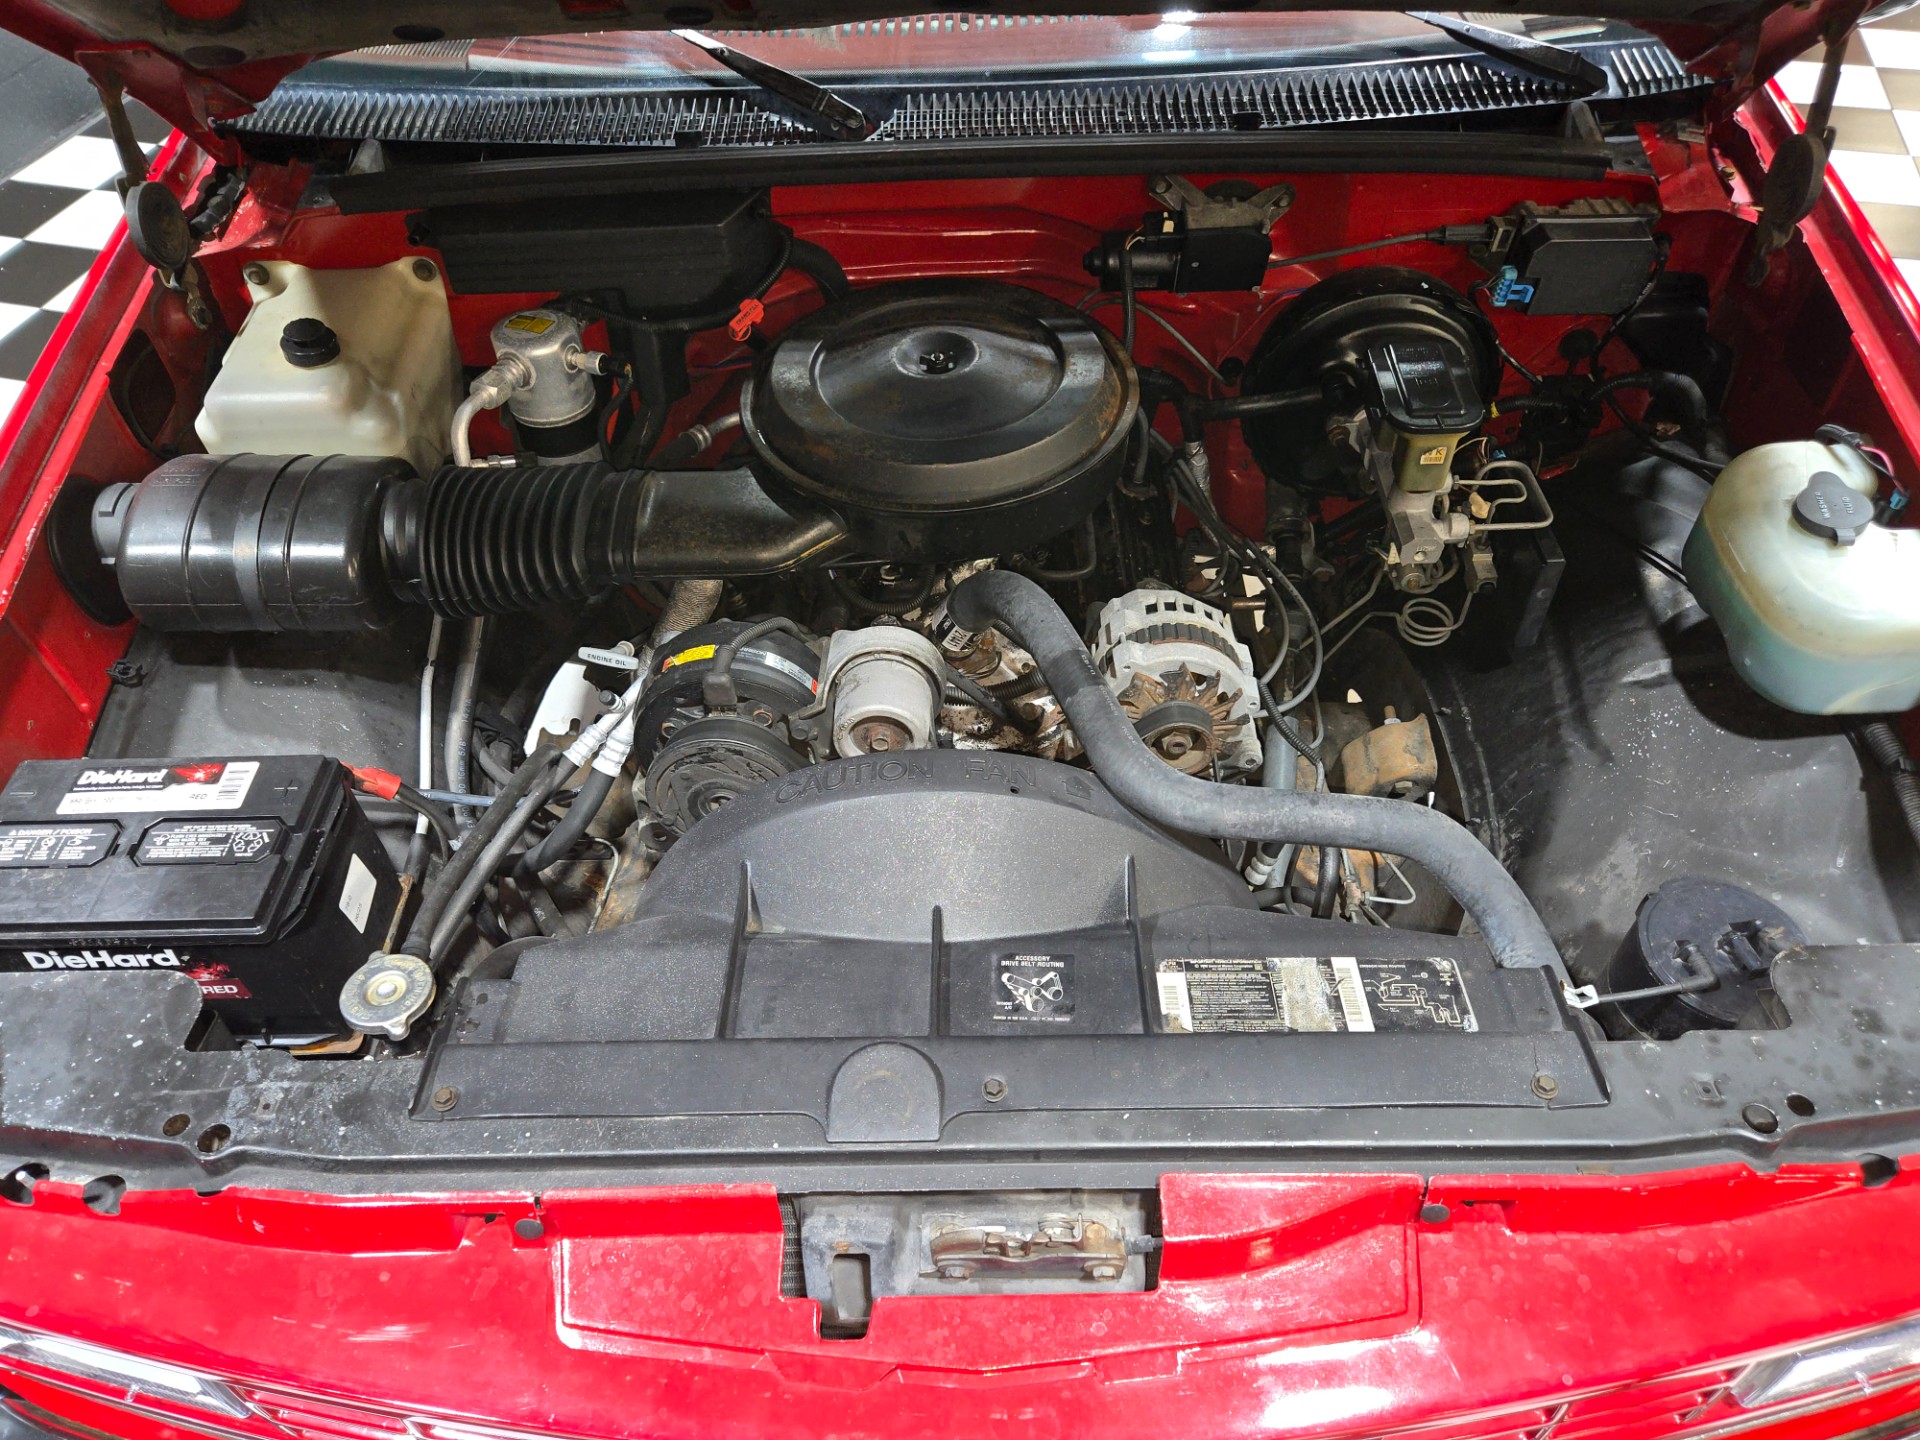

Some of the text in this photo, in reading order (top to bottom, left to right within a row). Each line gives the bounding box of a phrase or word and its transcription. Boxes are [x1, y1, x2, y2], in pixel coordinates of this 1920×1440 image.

[1814, 491, 1831, 519] WASHER
[1842, 496, 1854, 514] FLUID
[587, 653, 613, 664] ENGINE
[76, 768, 169, 785] DieHard
[775, 758, 1037, 804] CAUTION FAN
[22, 948, 181, 969] DieHard
[201, 984, 239, 994] RED
